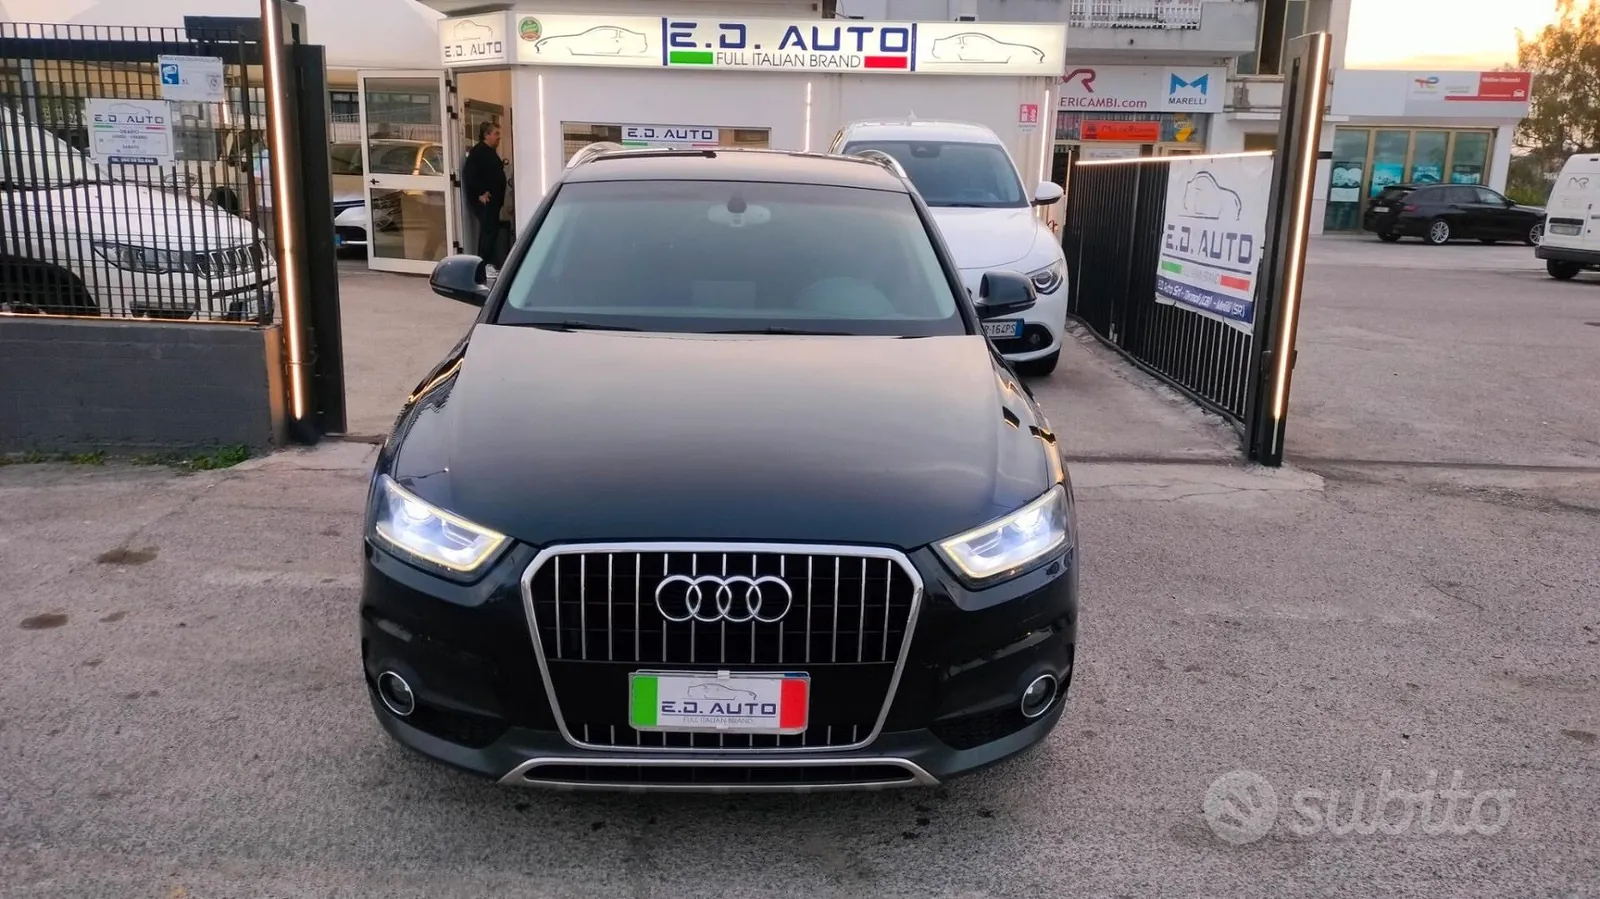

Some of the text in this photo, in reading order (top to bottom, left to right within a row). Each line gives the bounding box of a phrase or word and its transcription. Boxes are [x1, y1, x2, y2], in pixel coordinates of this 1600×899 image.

[670, 22, 909, 52] E.D. AUTO
[444, 41, 502, 57] E.D. AUTO
[717, 52, 861, 68] FULL ITALIAN BRAND
[1060, 97, 1147, 108] ERICAMBI.com
[1168, 97, 1207, 105] MARELLI
[94, 114, 164, 124] E.D. AUTO
[628, 128, 713, 140] E.D. AUTO
[1166, 224, 1253, 264] E.D. AUTO
[1231, 302, 1245, 318] (SR)
[661, 701, 777, 715] E.D. AUTO
